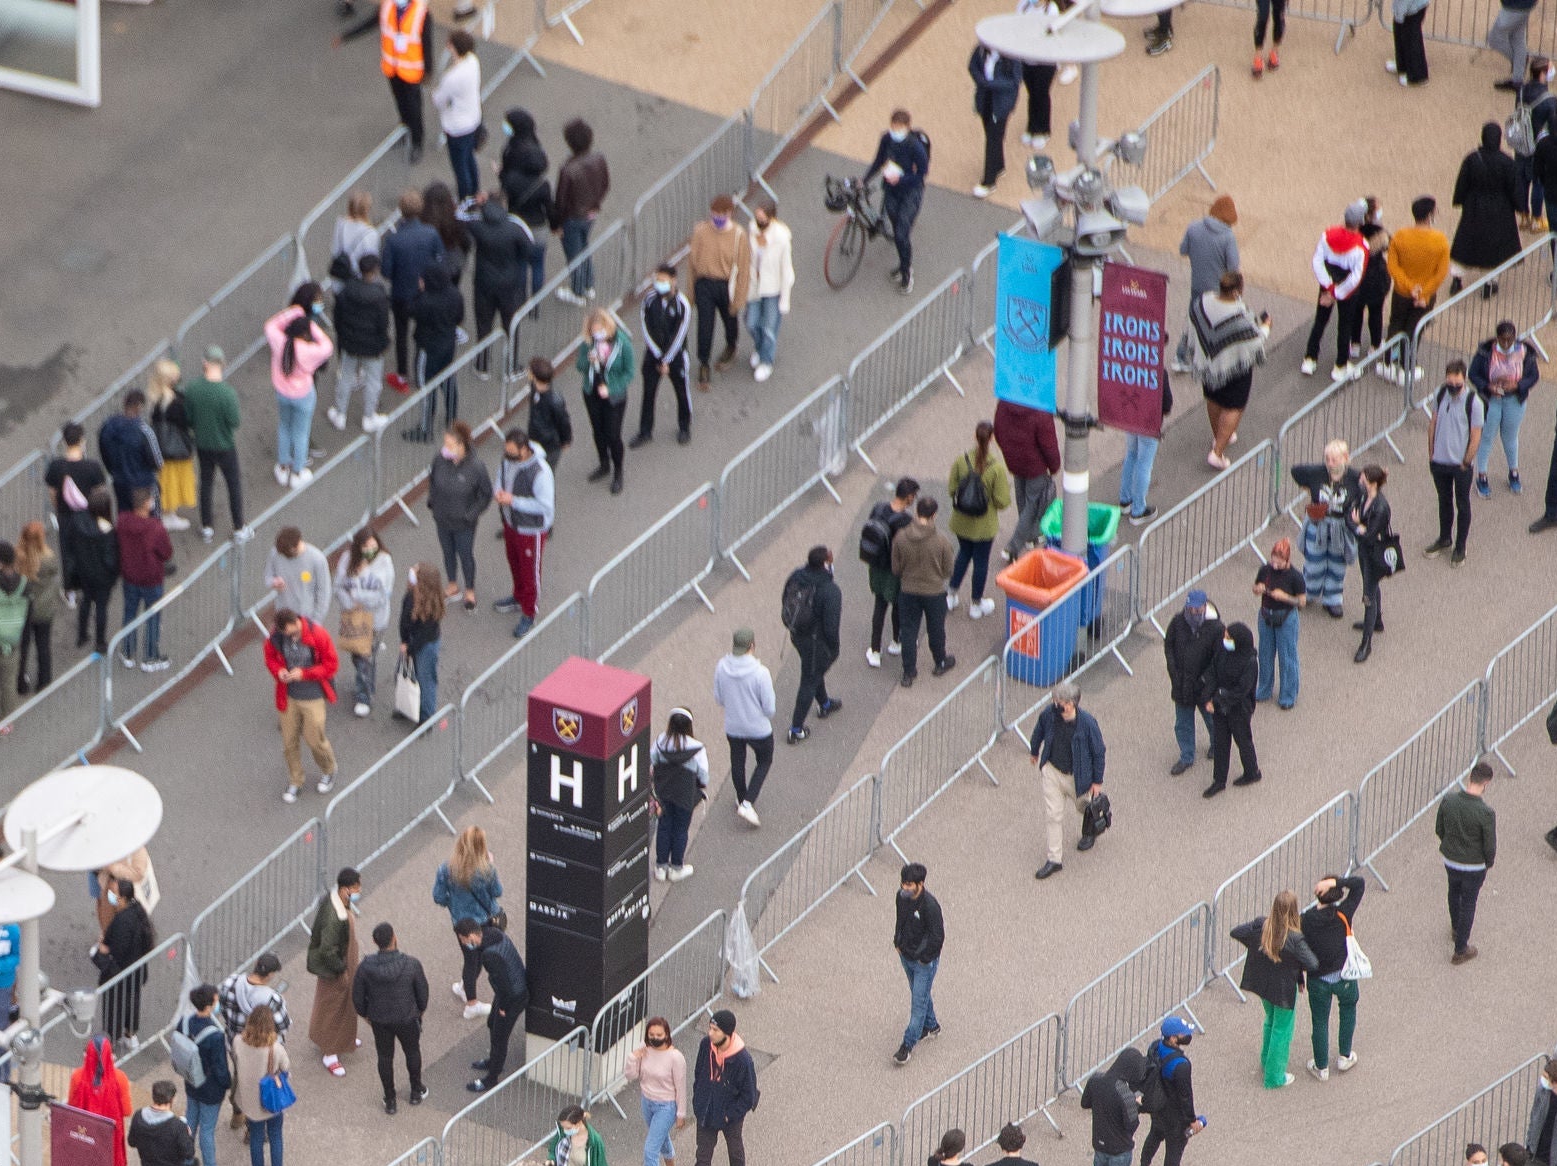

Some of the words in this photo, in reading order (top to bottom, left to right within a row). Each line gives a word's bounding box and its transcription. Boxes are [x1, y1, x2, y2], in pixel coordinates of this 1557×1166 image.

[1104, 311, 1160, 342] IRONS
[1103, 335, 1160, 366] IRONS
[1102, 359, 1159, 390] IRONS
[550, 753, 583, 809] H
[618, 743, 638, 803] H
